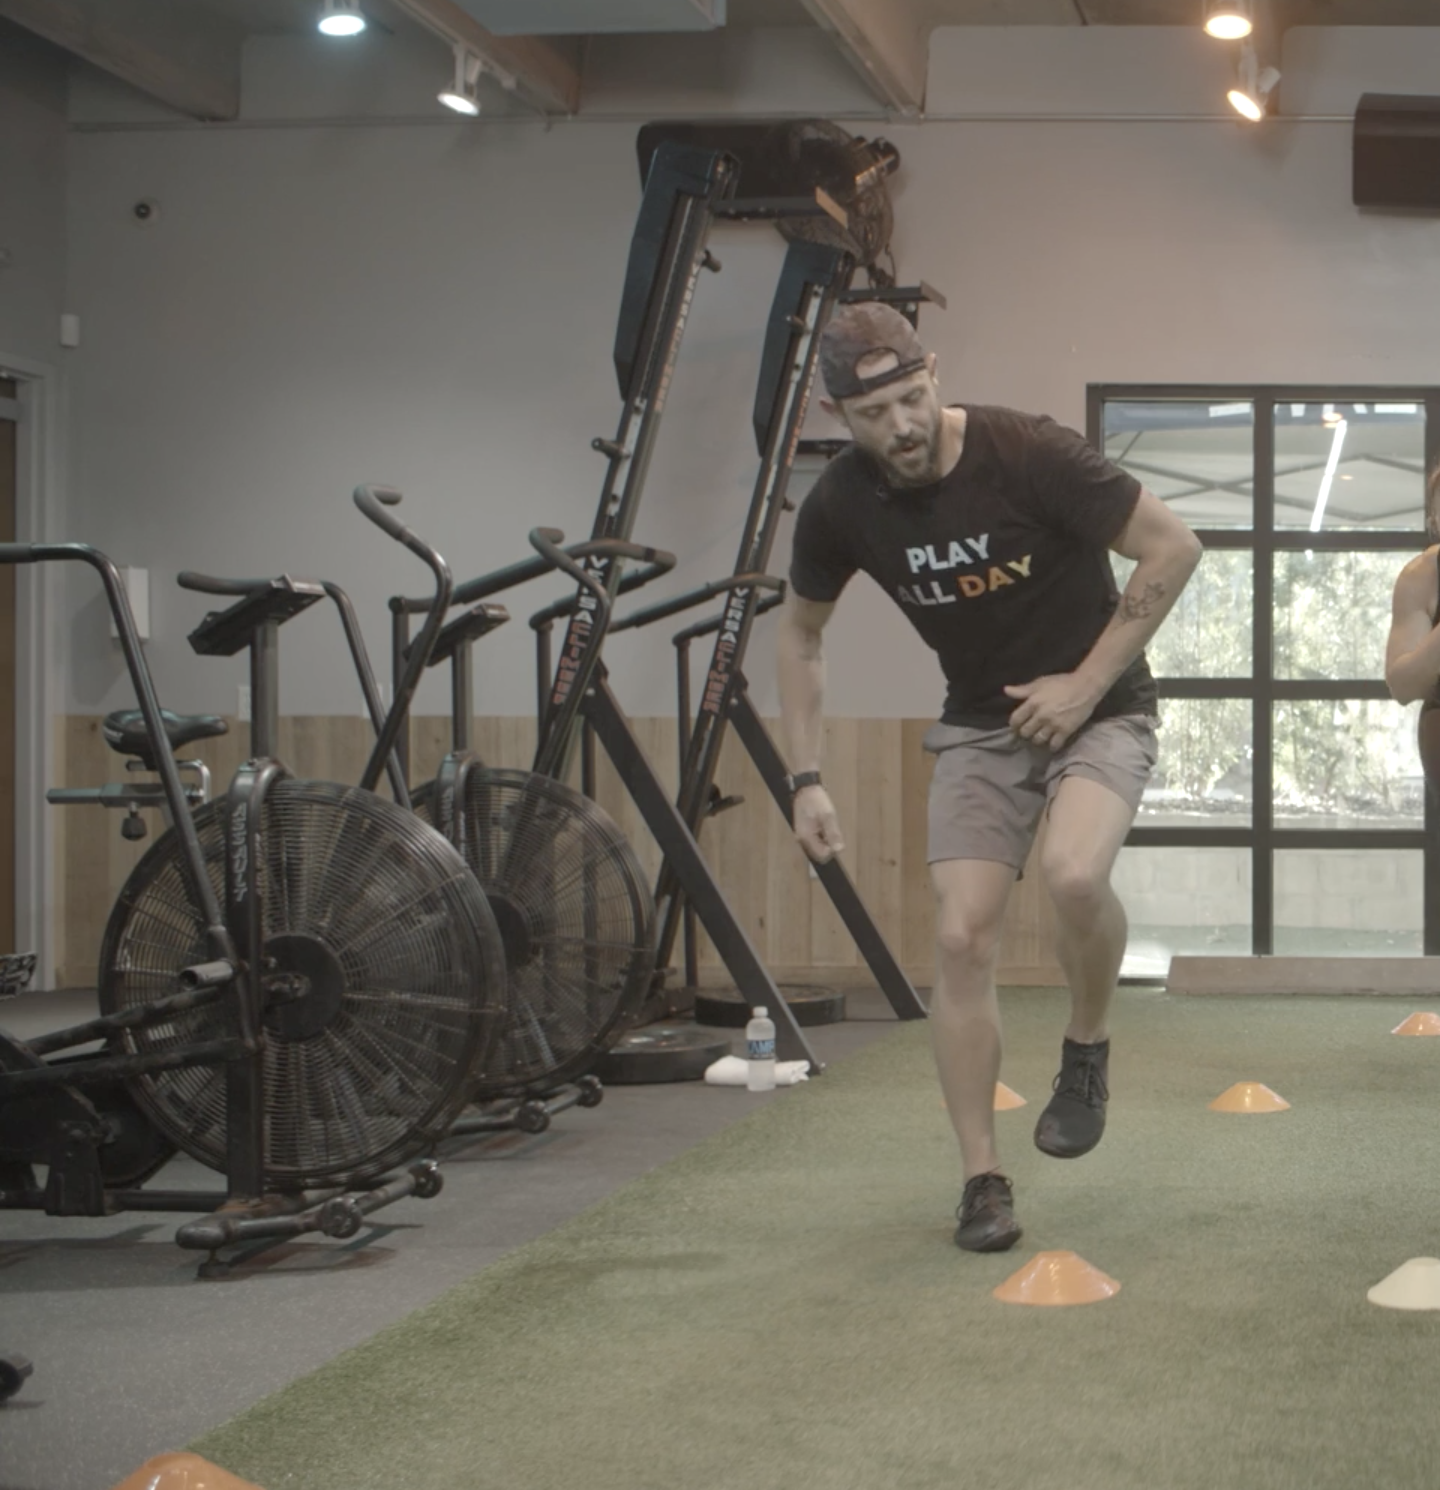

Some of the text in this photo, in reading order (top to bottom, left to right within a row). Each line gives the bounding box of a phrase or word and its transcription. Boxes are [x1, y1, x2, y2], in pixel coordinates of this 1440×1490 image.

[898, 554, 1032, 606] ALL DAY
[905, 532, 990, 574] PLAY
[552, 555, 609, 705] VESACLIMBER
[702, 586, 750, 714] VERSACLIMBER
[232, 801, 248, 902] ASSAULT
